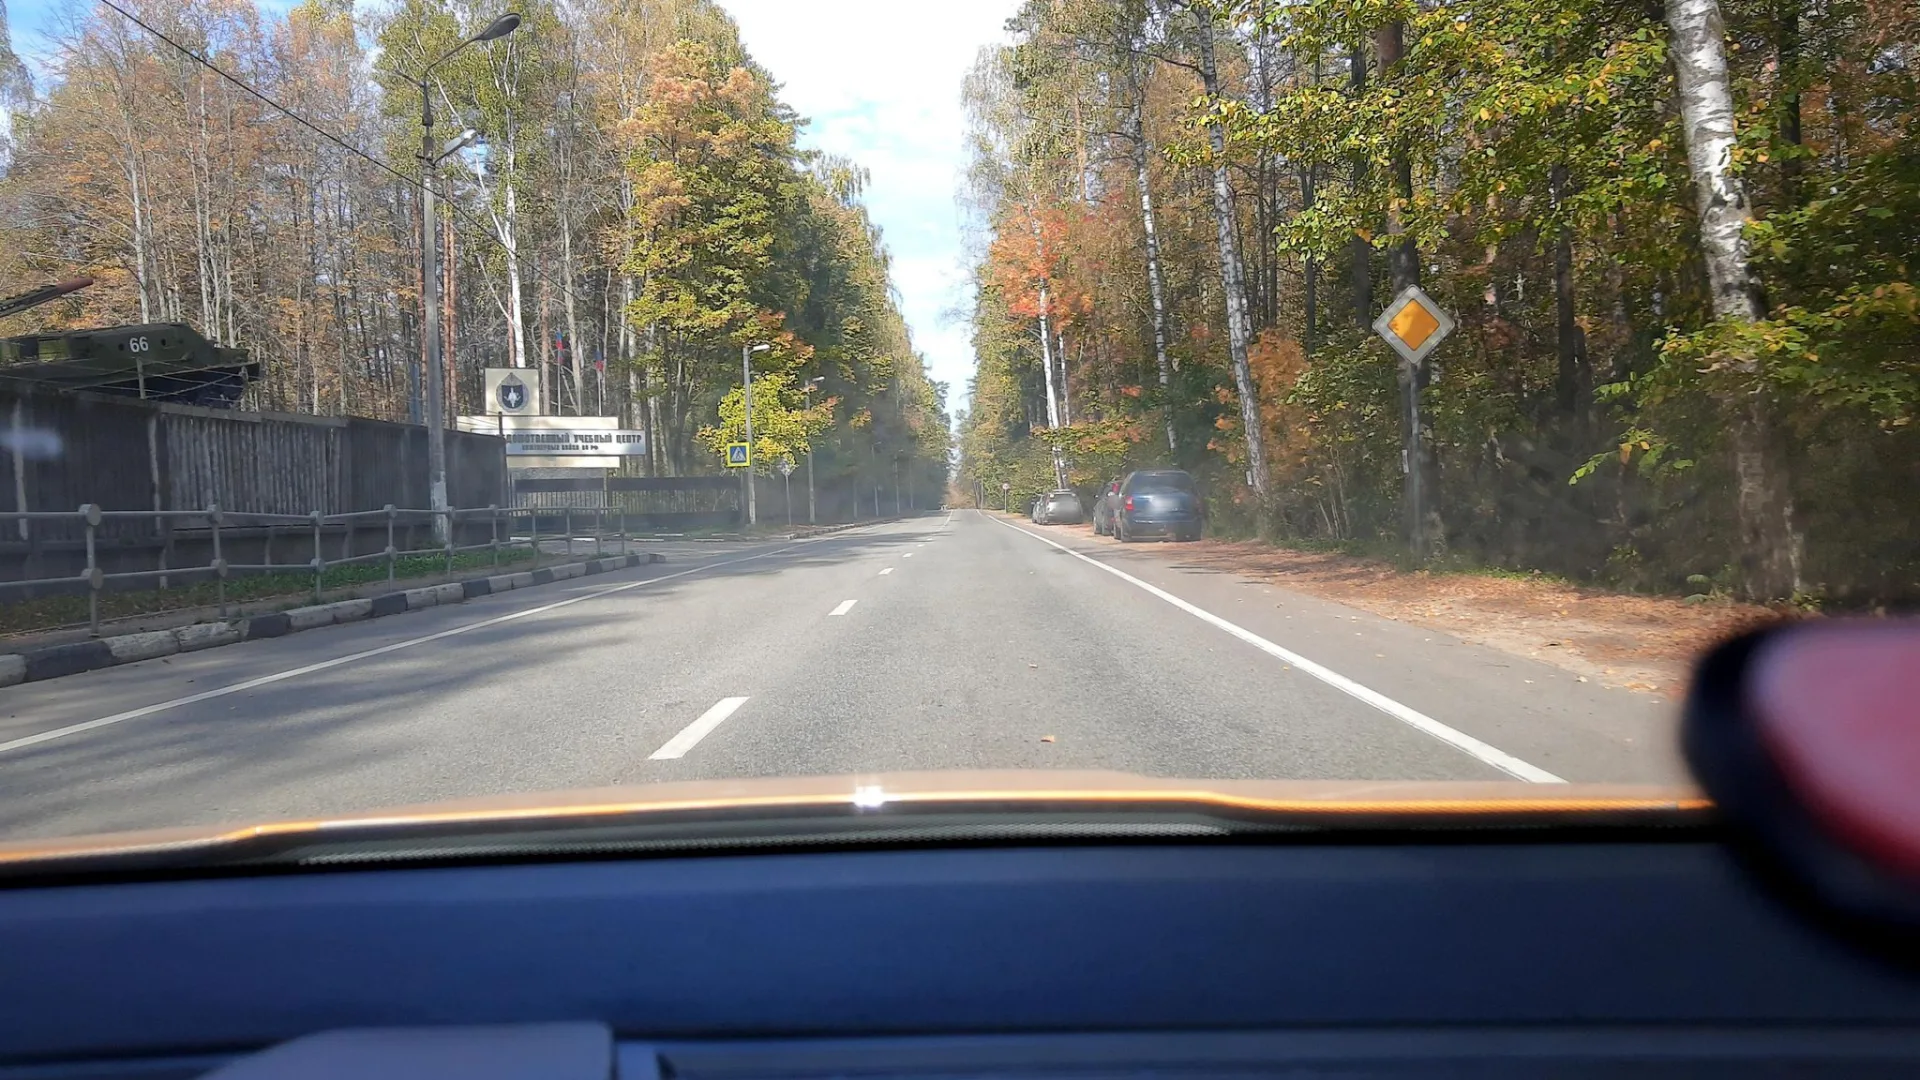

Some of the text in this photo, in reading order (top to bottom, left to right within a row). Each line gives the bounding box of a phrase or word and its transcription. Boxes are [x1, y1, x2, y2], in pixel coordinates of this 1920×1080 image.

[129, 336, 149, 353] 66
[573, 433, 613, 443] УЧЕБНЫЙ
[616, 434, 642, 444] ЦЕНТР
